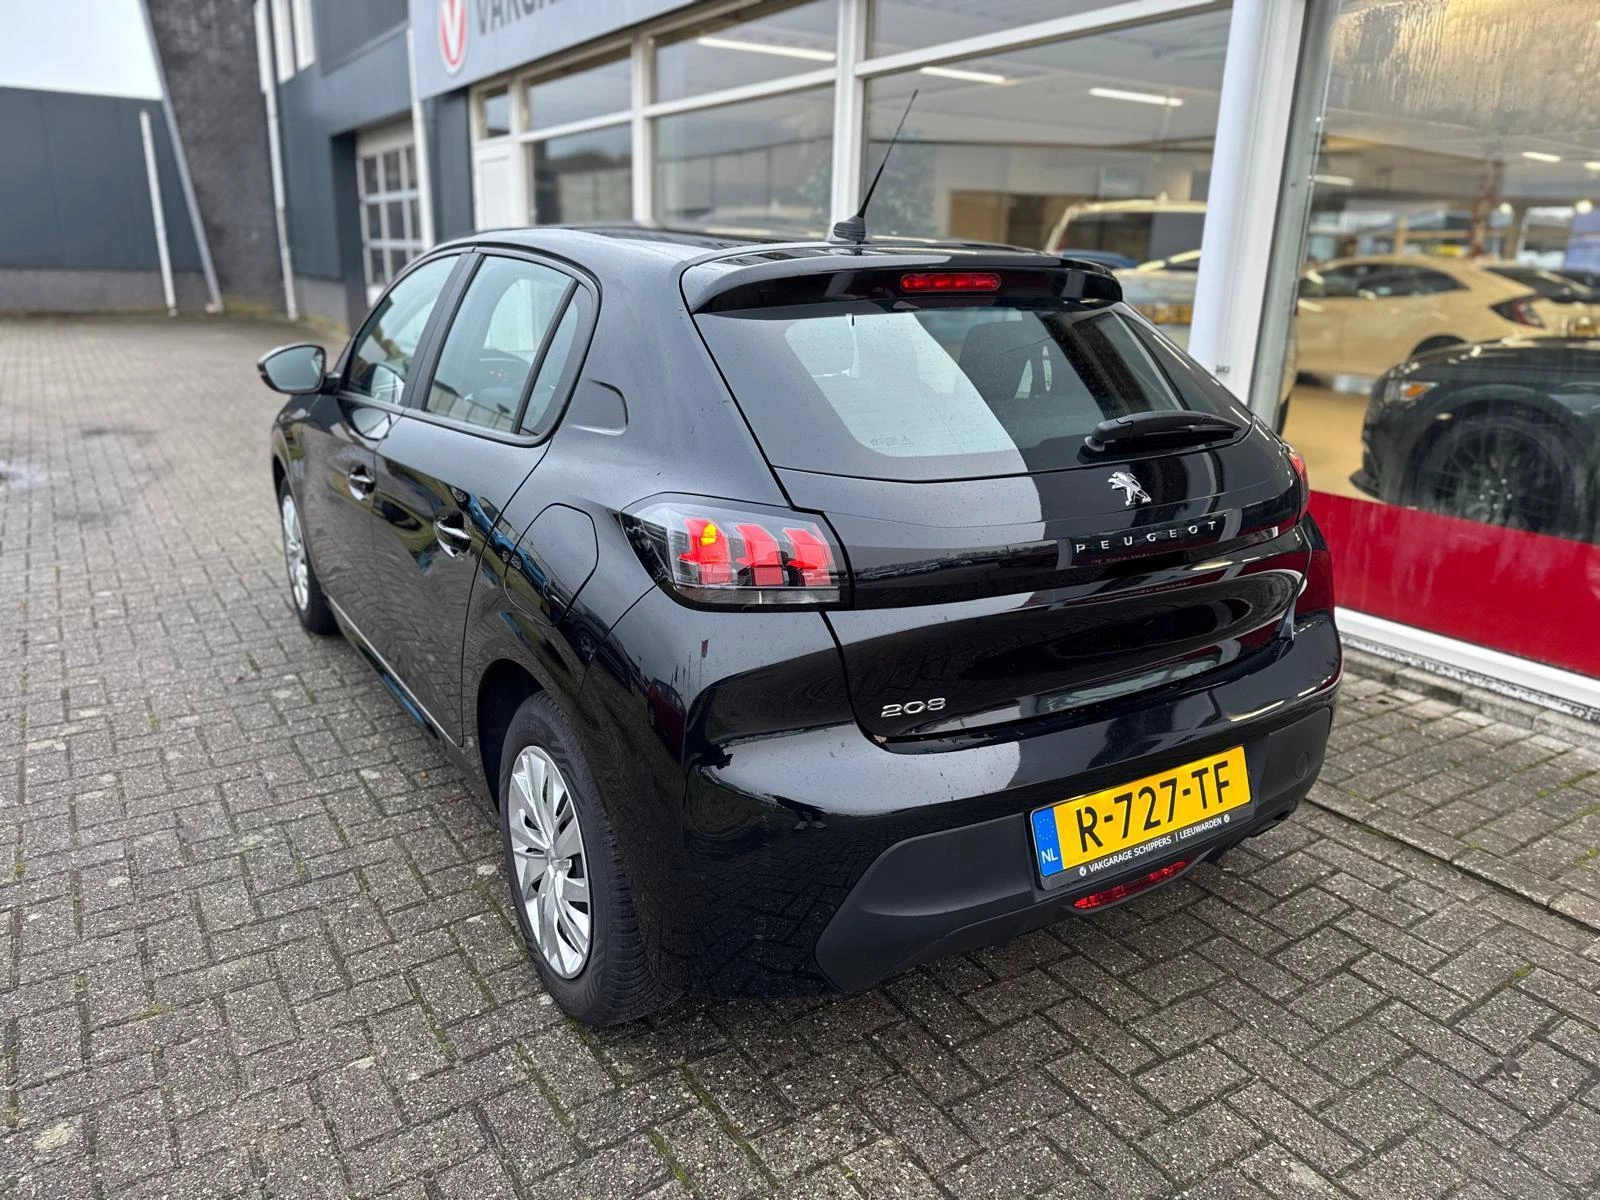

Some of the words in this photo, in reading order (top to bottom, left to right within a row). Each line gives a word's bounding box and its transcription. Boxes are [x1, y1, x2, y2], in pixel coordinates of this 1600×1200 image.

[1075, 520, 1217, 554] PEUGEOT
[881, 697, 946, 718] 208
[1076, 760, 1230, 853] R-727-TF
[1041, 847, 1059, 865] NL
[1088, 850, 1133, 873] VAKGARAGE
[1134, 835, 1172, 857] SCHIPPERS
[1179, 817, 1223, 840] LEEUWARDEN
